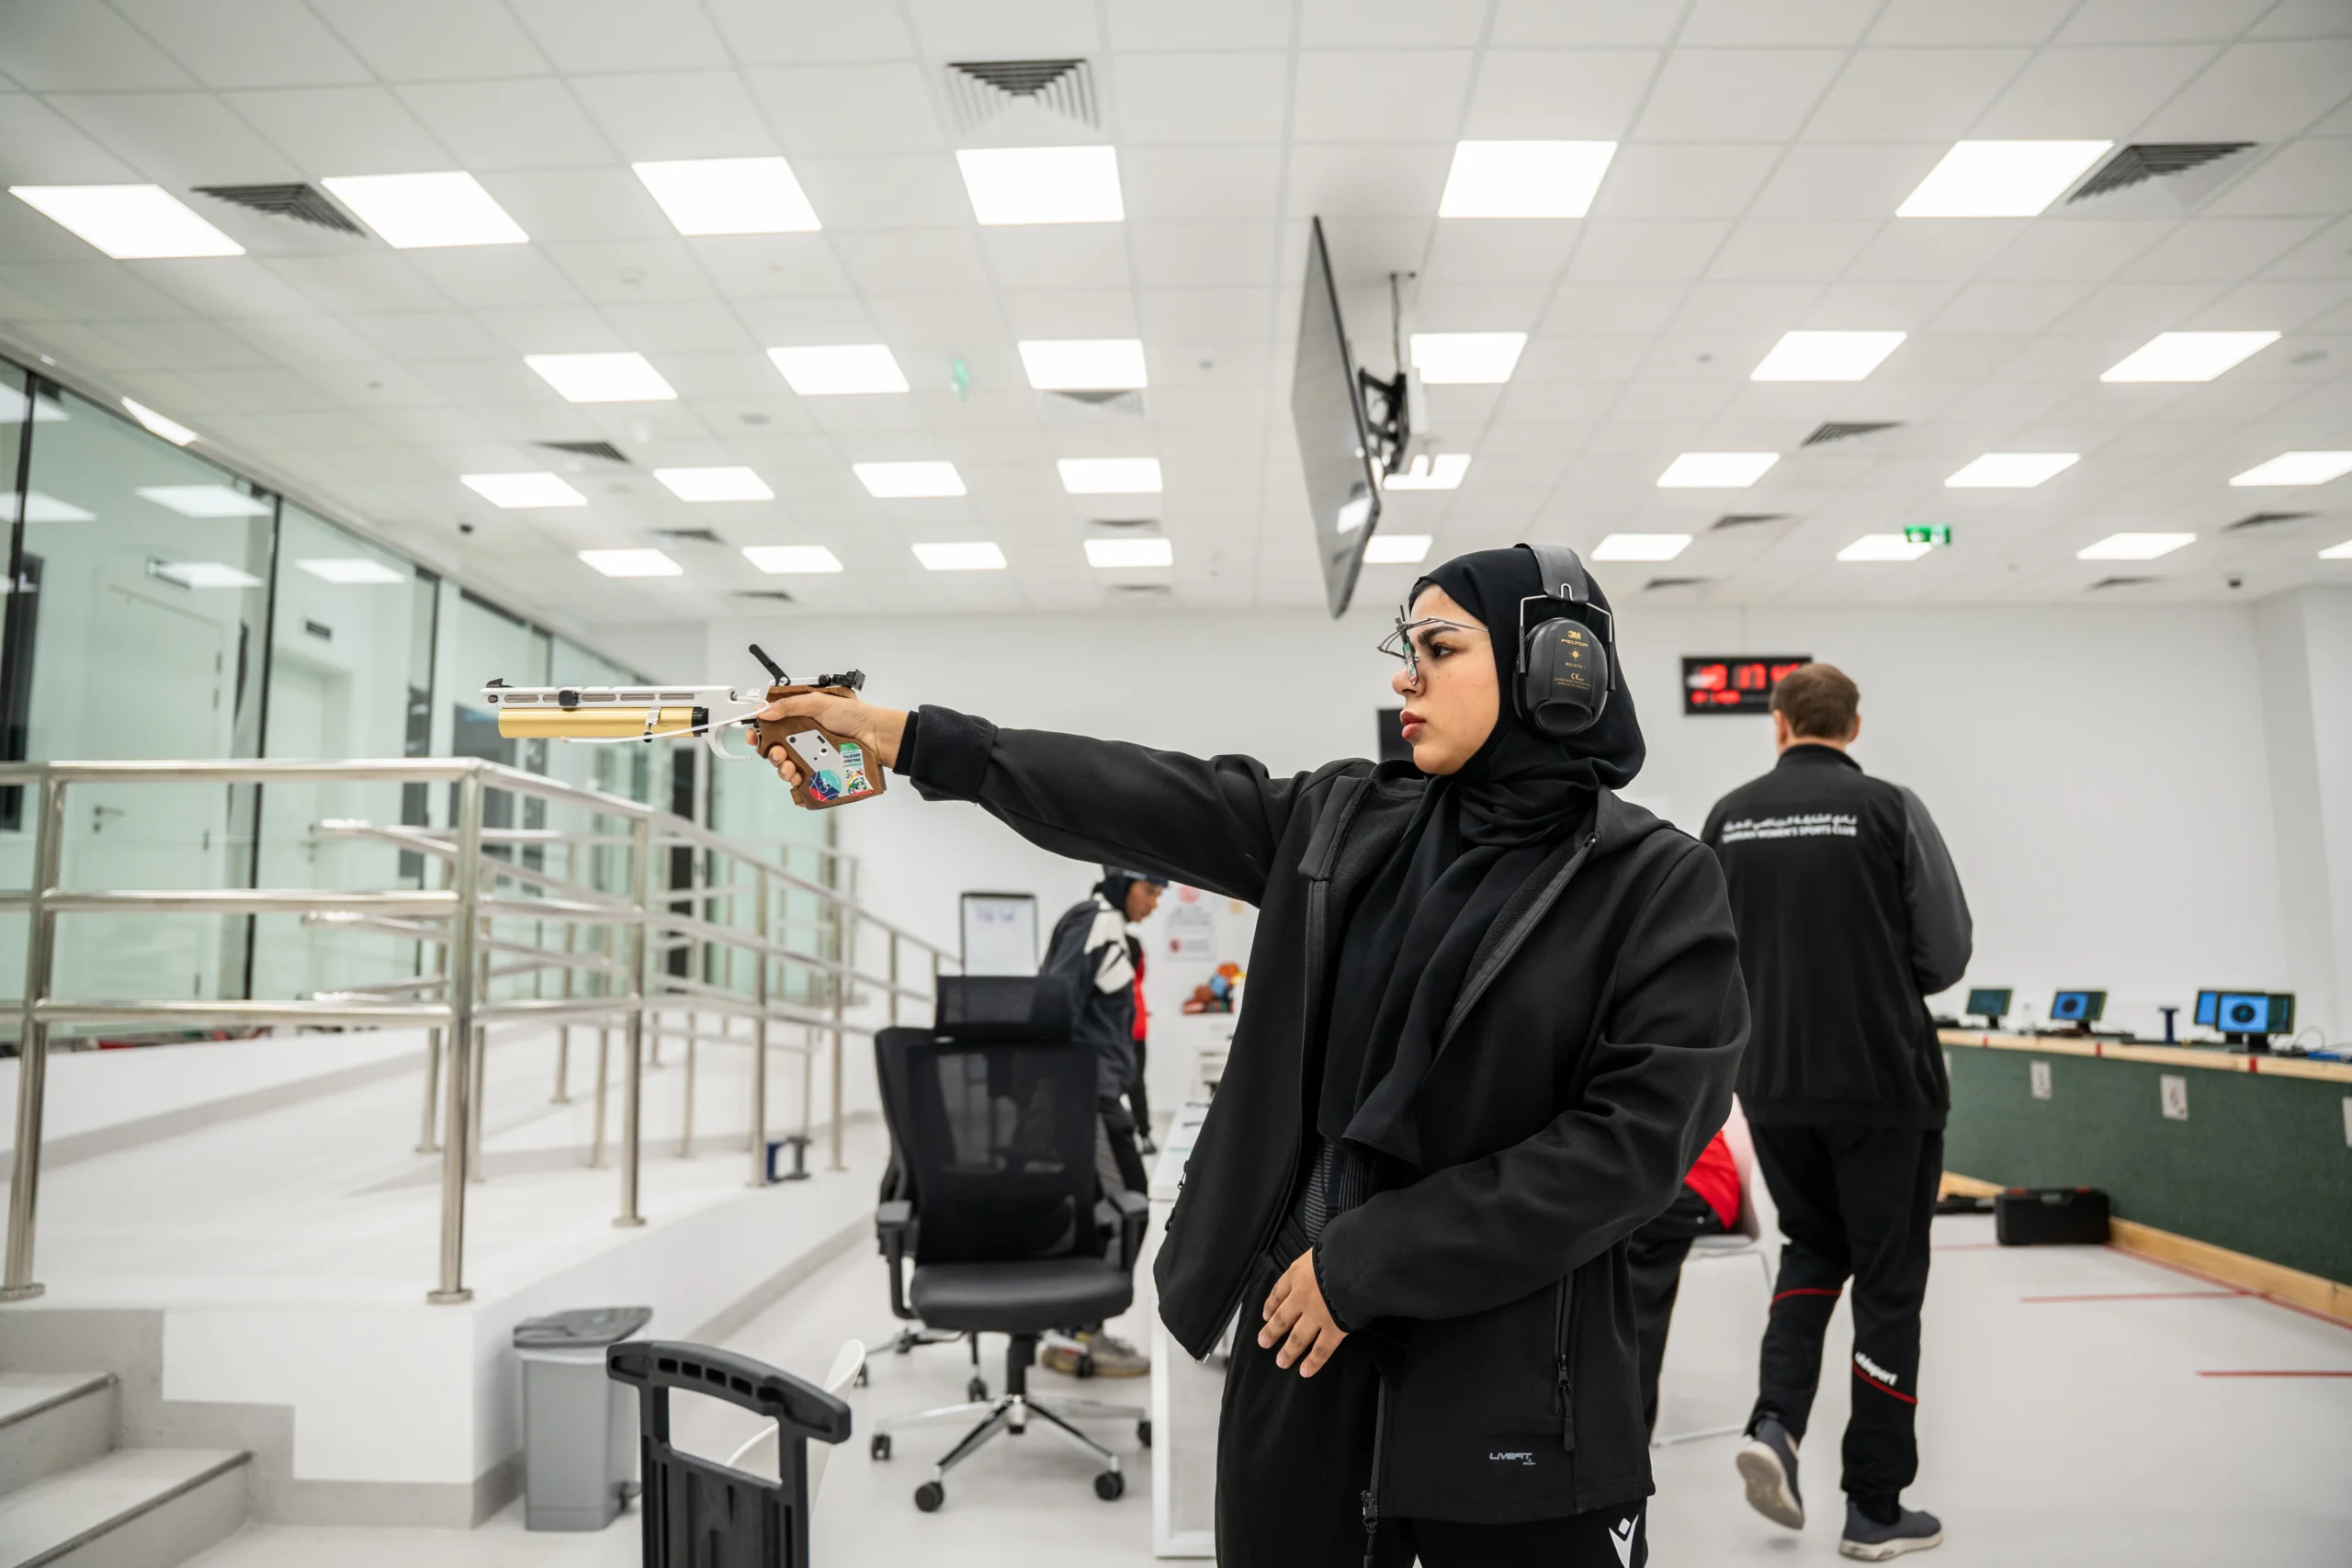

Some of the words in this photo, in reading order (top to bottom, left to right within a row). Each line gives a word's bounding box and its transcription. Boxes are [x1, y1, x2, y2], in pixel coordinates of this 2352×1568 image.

[1567, 630, 1581, 639] 3M
[1561, 638, 1589, 647] PELTOR
[1799, 825, 1831, 836] SPORTS
[1832, 825, 1858, 837] CLUB
